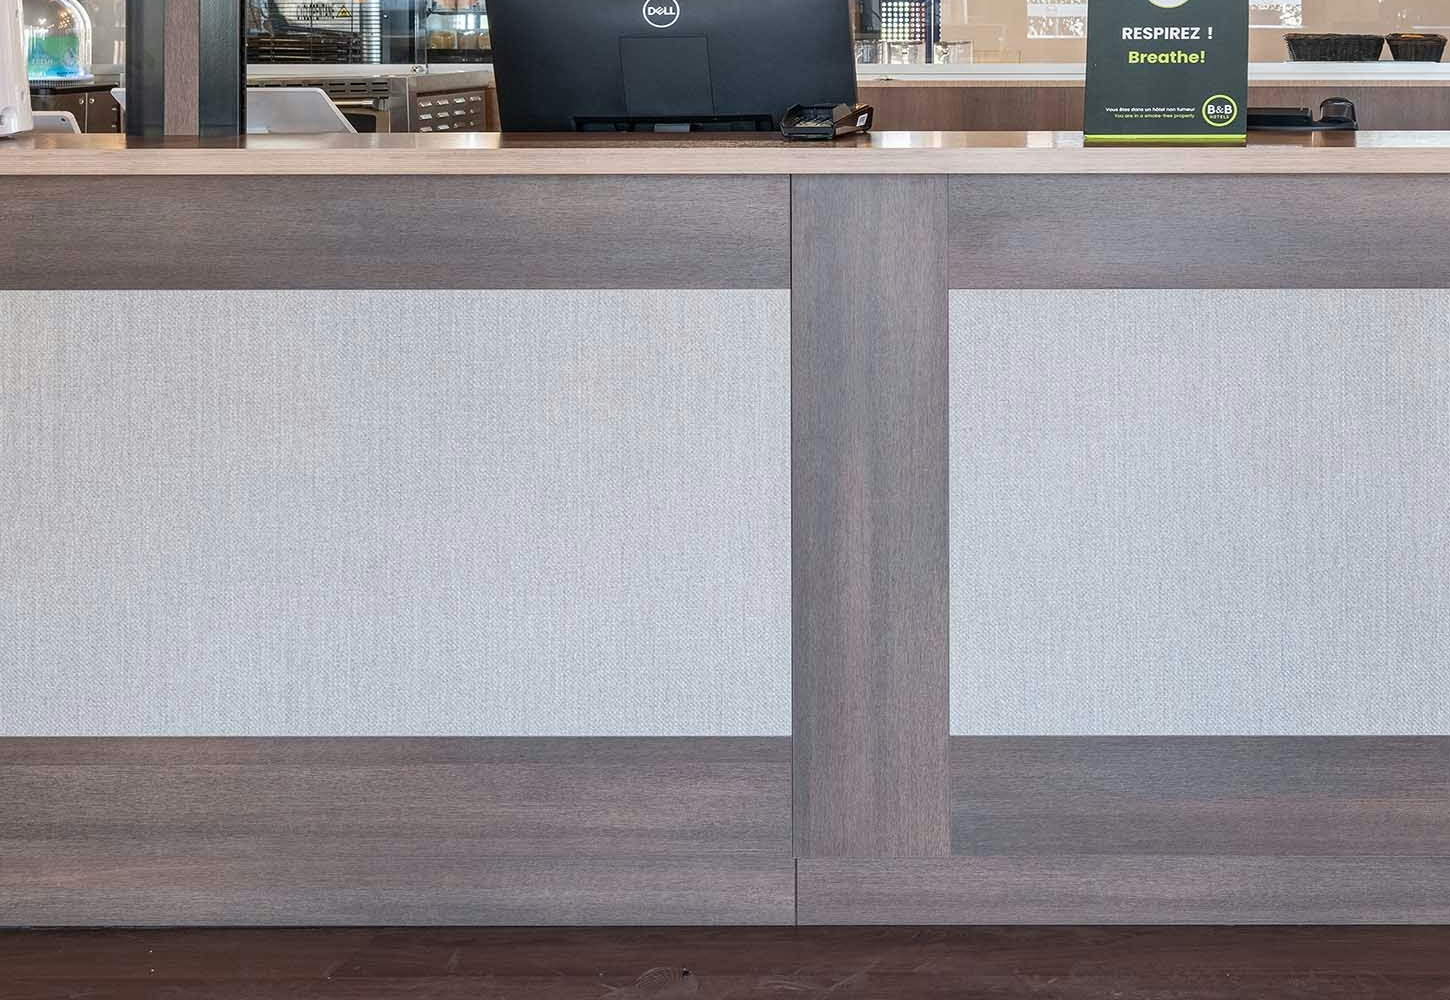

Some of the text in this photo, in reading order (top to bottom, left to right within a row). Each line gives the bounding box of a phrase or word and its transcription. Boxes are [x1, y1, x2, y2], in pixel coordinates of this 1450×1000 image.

[647, 6, 676, 15] DELL
[1121, 26, 1201, 40] RESPIREZ
[1128, 50, 1206, 64] Breathe!
[1207, 104, 1233, 114] B&B
